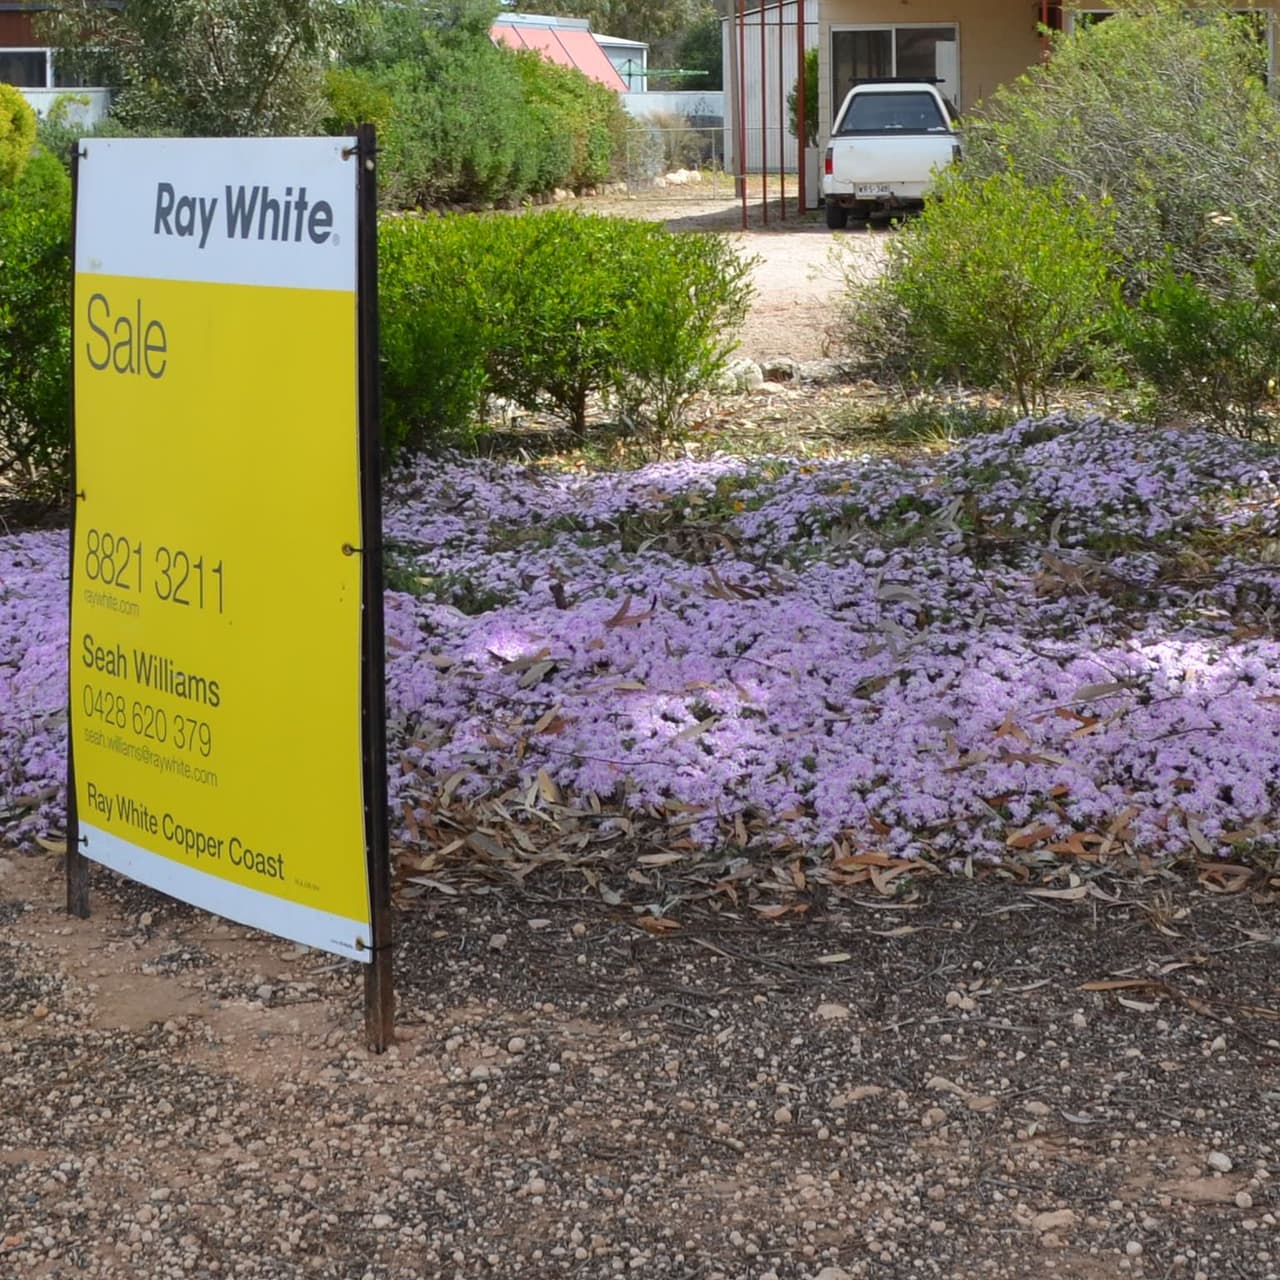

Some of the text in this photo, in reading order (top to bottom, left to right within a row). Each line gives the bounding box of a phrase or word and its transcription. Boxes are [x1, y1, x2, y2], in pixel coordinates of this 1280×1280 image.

[153, 182, 334, 249] Ray White
[86, 293, 168, 380] Sale
[83, 589, 140, 617] raywhite.com
[85, 528, 224, 614] 8821 3211
[82, 633, 221, 708] Seah Williams
[83, 684, 212, 758] 0428 620 379
[87, 781, 286, 881] Ray White Copper Coast
